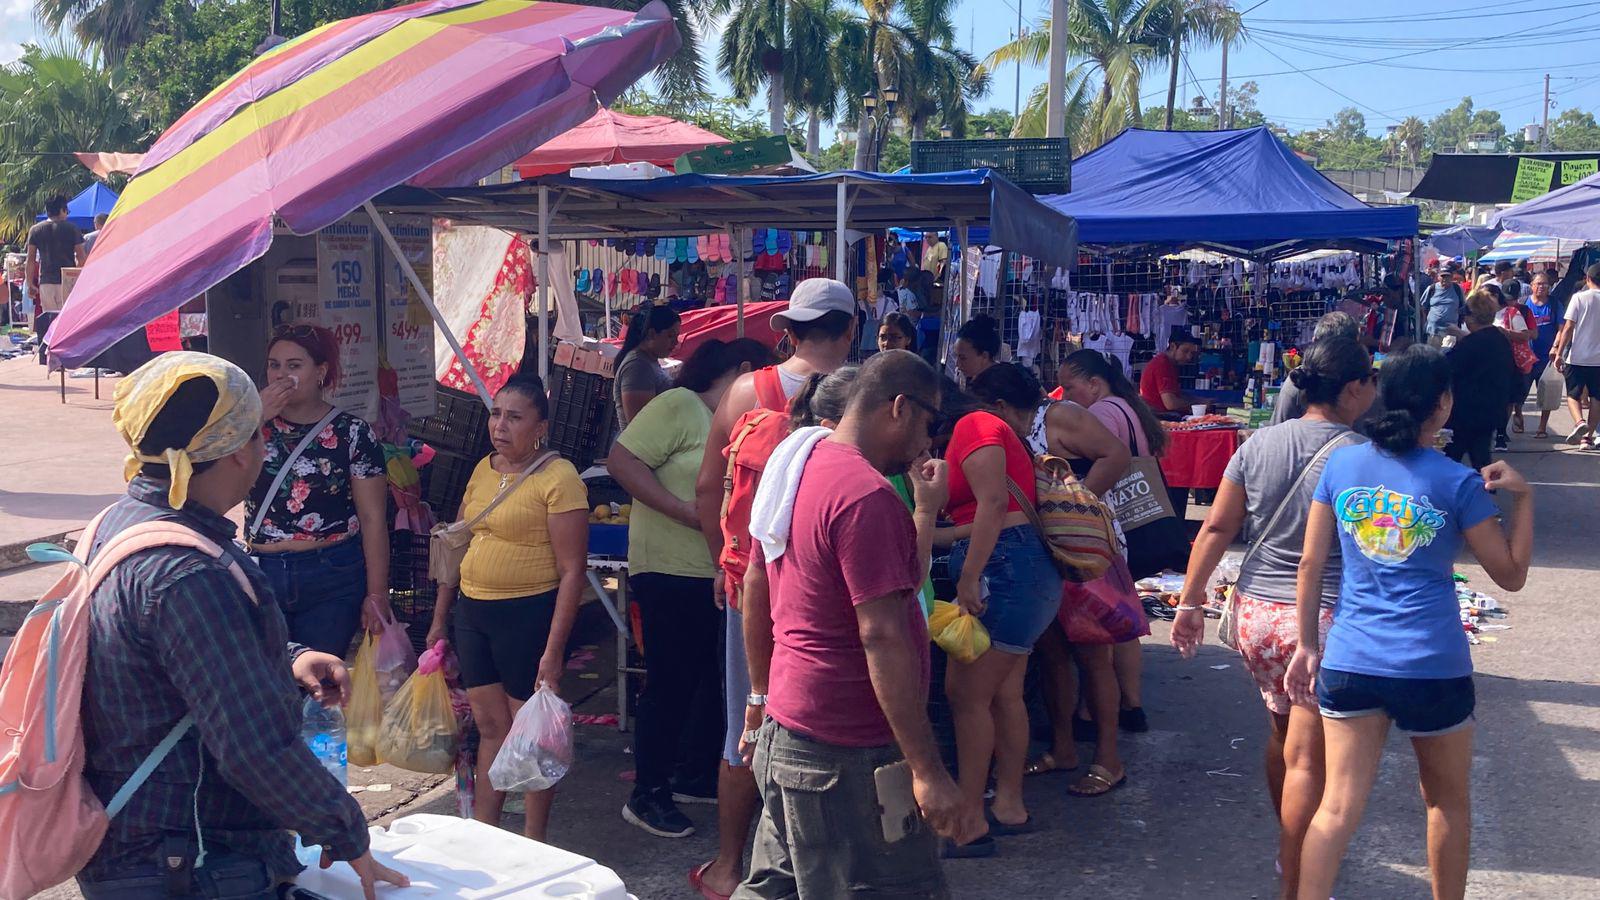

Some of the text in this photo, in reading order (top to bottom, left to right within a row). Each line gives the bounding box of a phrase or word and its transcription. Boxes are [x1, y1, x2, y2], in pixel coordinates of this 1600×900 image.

[331, 260, 362, 284] 150
[337, 286, 361, 298] MEGAS
[1336, 484, 1448, 529] Caddy's
